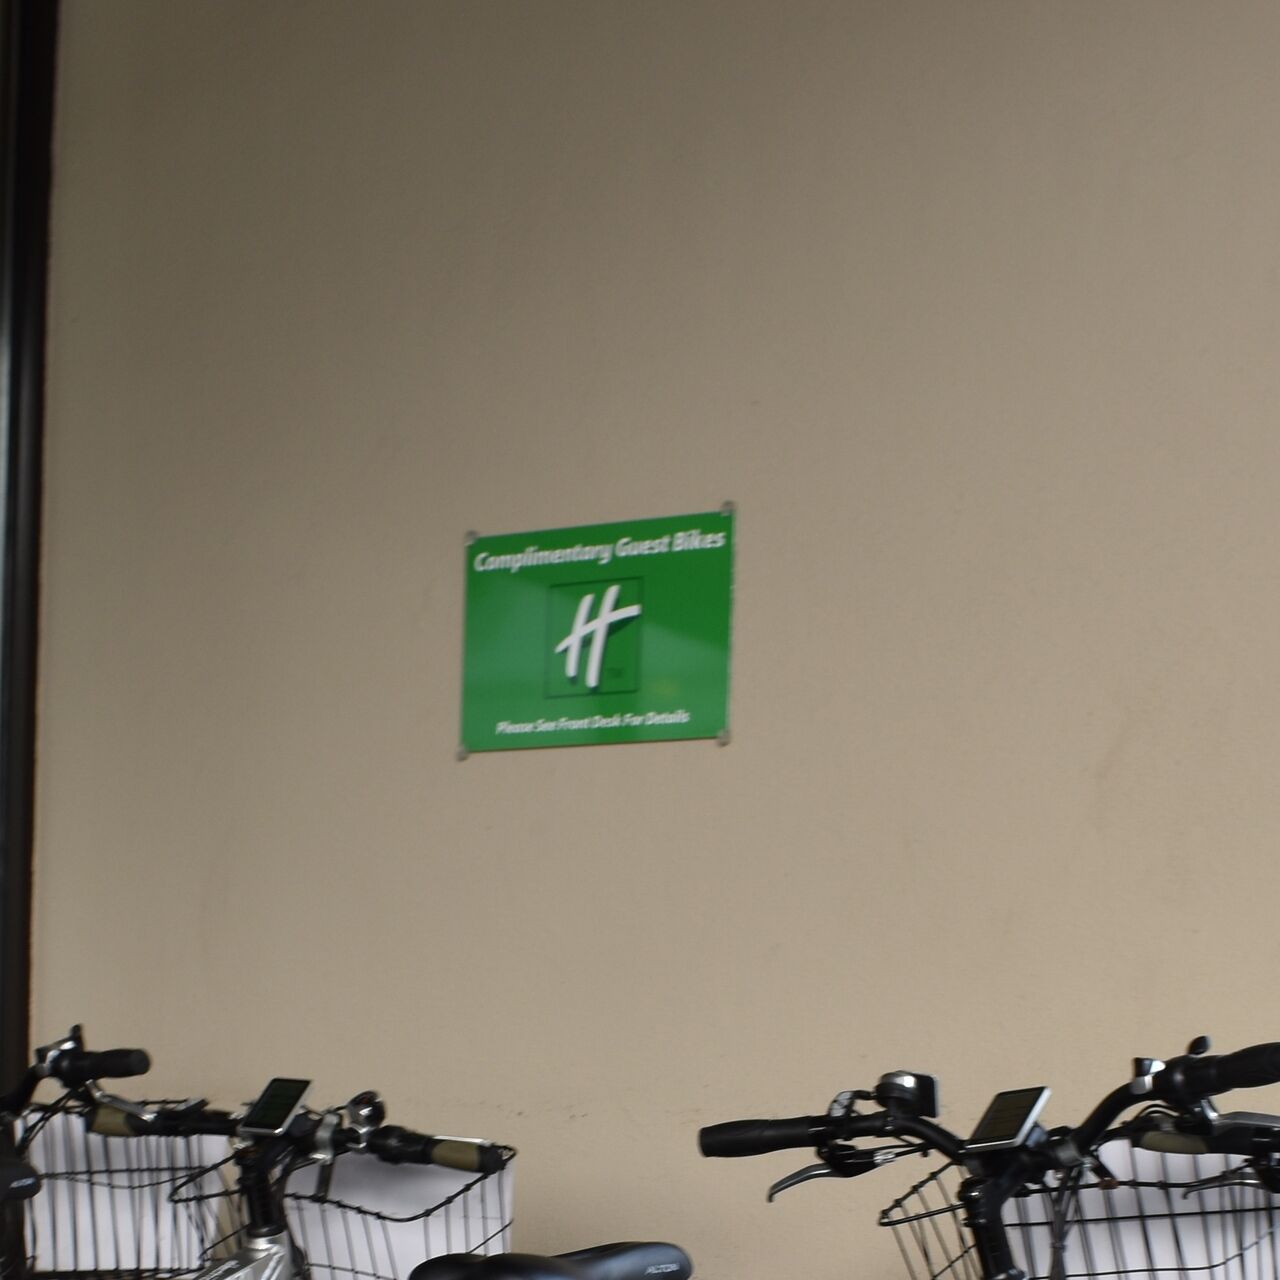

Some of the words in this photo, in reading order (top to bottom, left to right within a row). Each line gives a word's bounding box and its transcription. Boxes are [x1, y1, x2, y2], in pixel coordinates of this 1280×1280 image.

[474, 542, 613, 573] Complimentary
[614, 536, 670, 557] Guest
[671, 529, 726, 552] Bikes
[555, 584, 642, 688] H
[495, 721, 535, 735] Please
[535, 718, 556, 732] See
[556, 716, 589, 731] Front
[590, 714, 622, 728] Desk
[621, 712, 642, 727] For
[644, 709, 690, 726] Details
